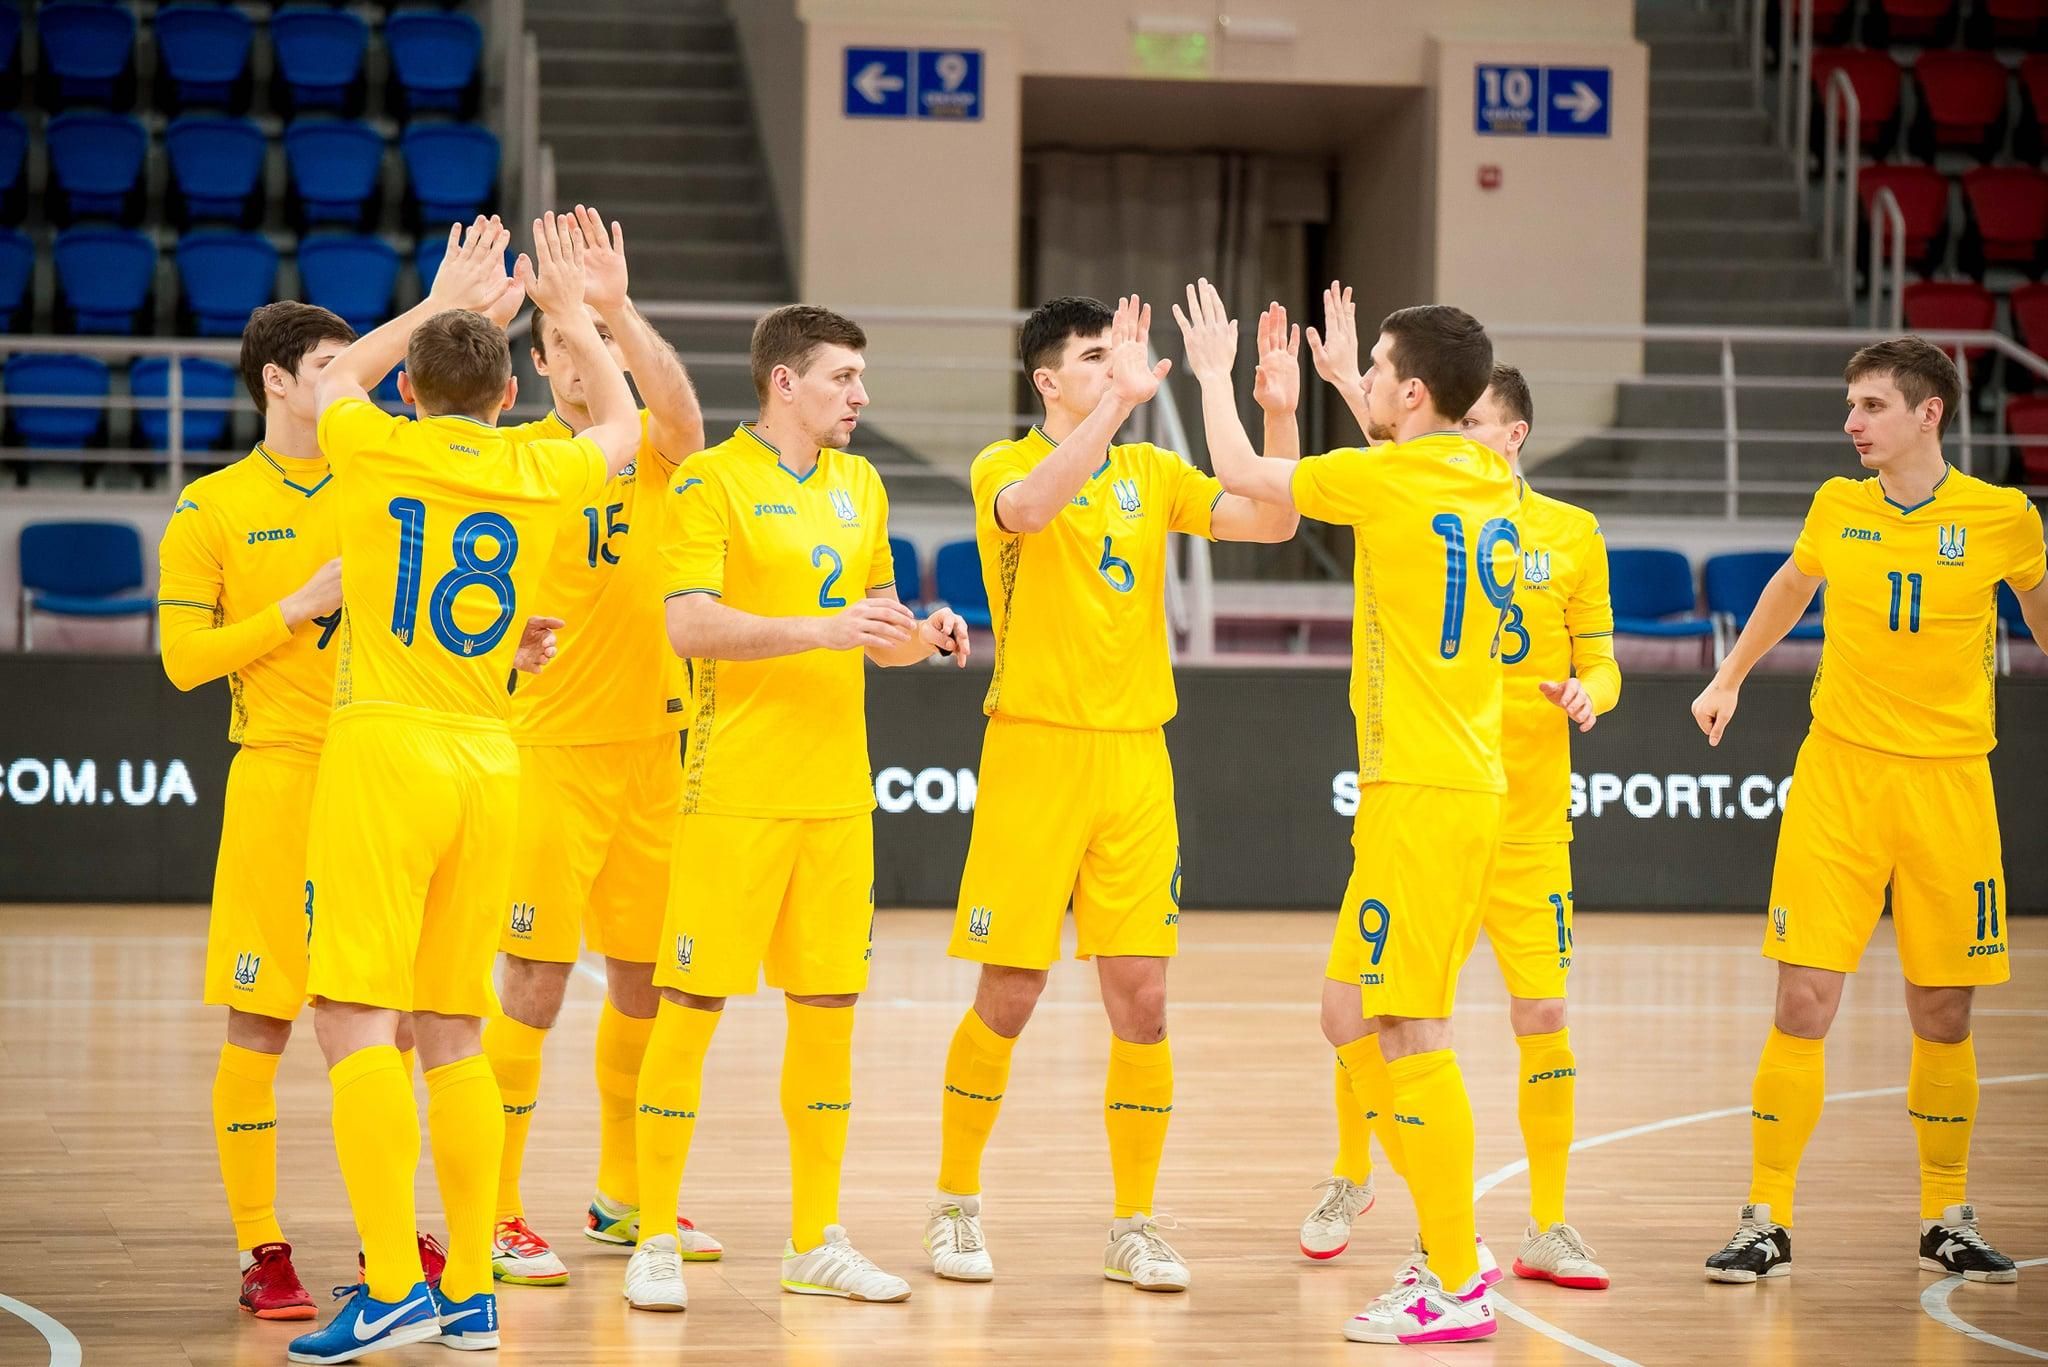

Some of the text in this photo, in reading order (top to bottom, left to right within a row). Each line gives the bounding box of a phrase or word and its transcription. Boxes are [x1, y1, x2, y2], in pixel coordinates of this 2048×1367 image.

[935, 53, 969, 91] 9
[1481, 69, 1533, 107] 10
[584, 502, 630, 568] 15
[1098, 536, 1135, 592] 6
[388, 497, 519, 658] 18
[812, 545, 846, 608] 2
[1432, 513, 1521, 660] 19
[1887, 571, 1923, 633] 11
[0, 758, 198, 806] OM.UA
[1359, 899, 1390, 965] 9
[1549, 892, 1574, 953] 1
[1974, 878, 1999, 940] 11
